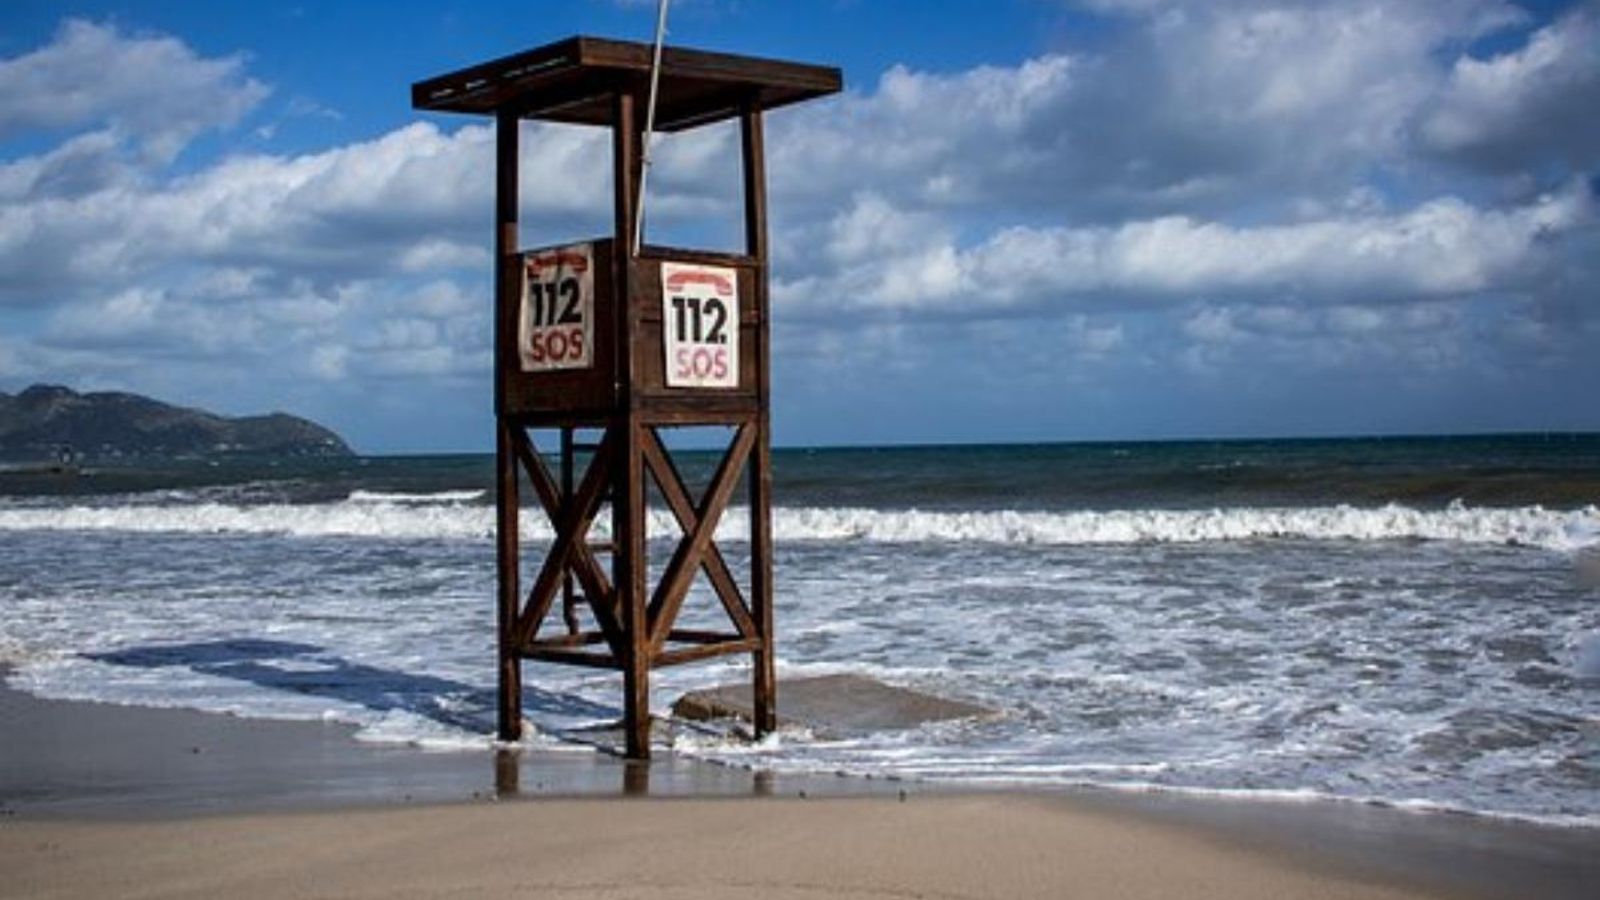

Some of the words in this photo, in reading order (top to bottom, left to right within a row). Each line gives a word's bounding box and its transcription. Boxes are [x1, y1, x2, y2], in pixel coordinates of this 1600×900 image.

[531, 277, 583, 326] 112
[532, 329, 583, 361] SOS
[677, 347, 728, 379] SOS
